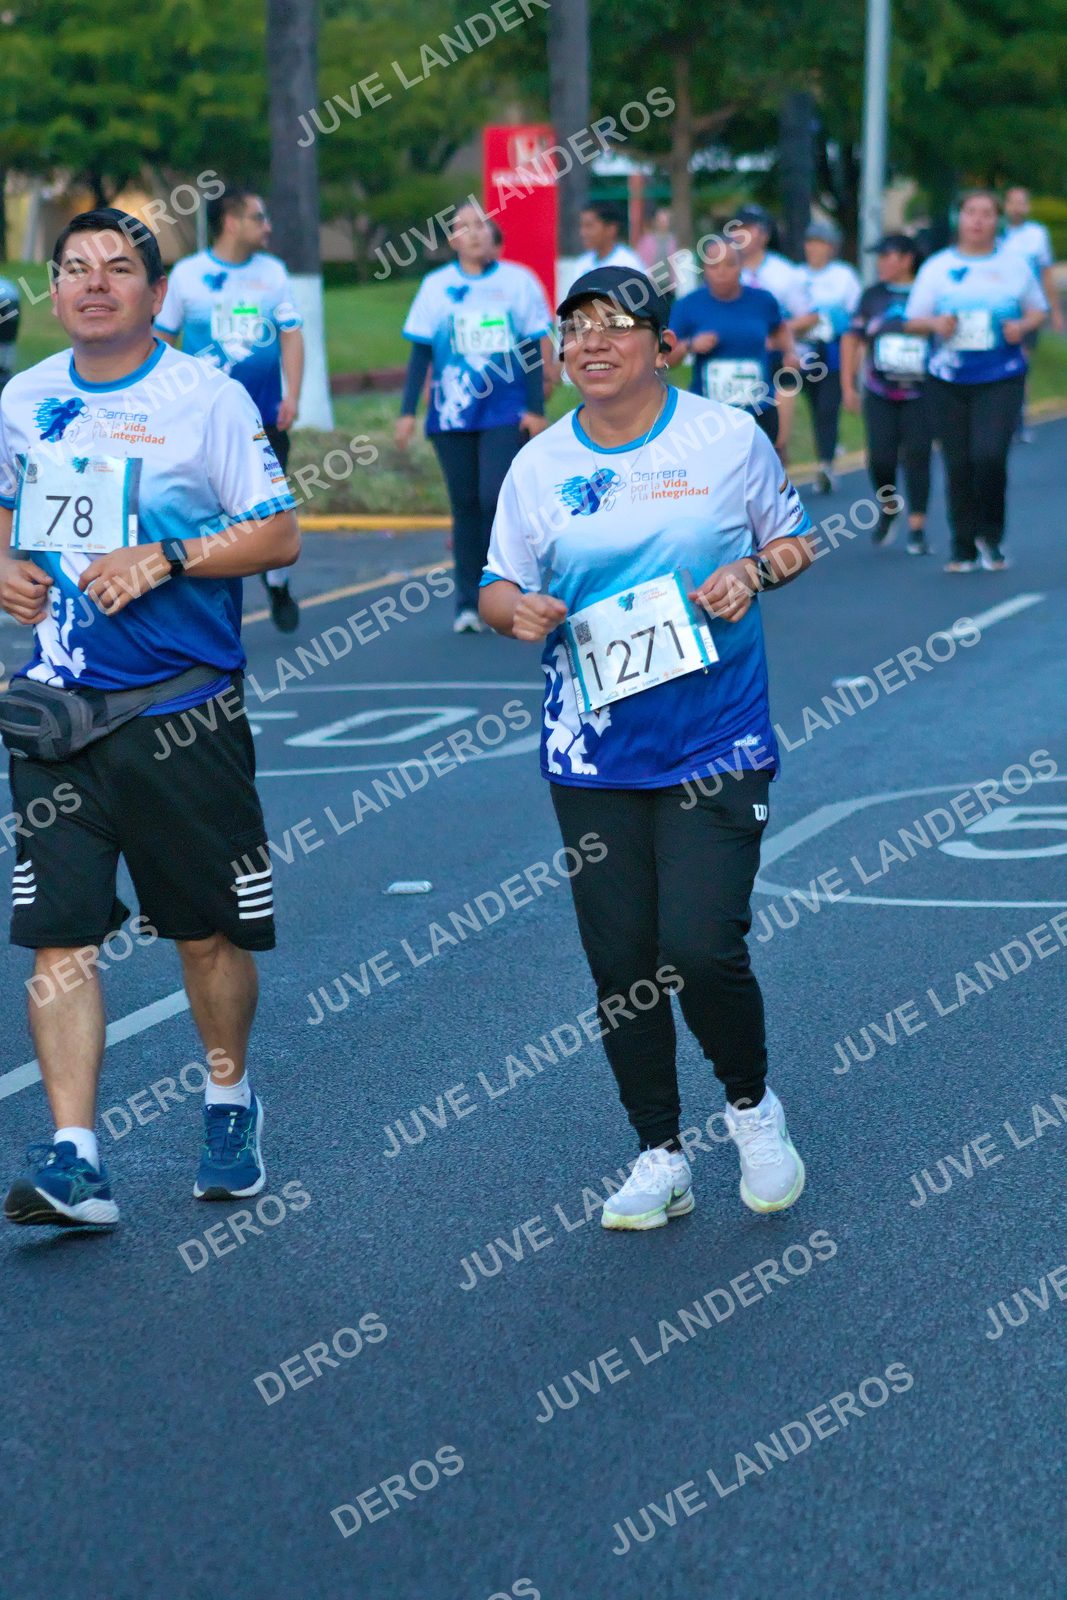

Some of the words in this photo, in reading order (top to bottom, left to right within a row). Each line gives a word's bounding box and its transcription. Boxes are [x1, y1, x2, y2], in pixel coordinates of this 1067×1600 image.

[97, 408, 148, 422] Carrera
[123, 421, 146, 432] Vida
[110, 431, 165, 445] Integridad
[631, 469, 687, 482] Carrera
[663, 479, 688, 488] Vida
[651, 486, 709, 500] Integridad
[46, 496, 93, 538] 78
[586, 620, 685, 691] 1271
